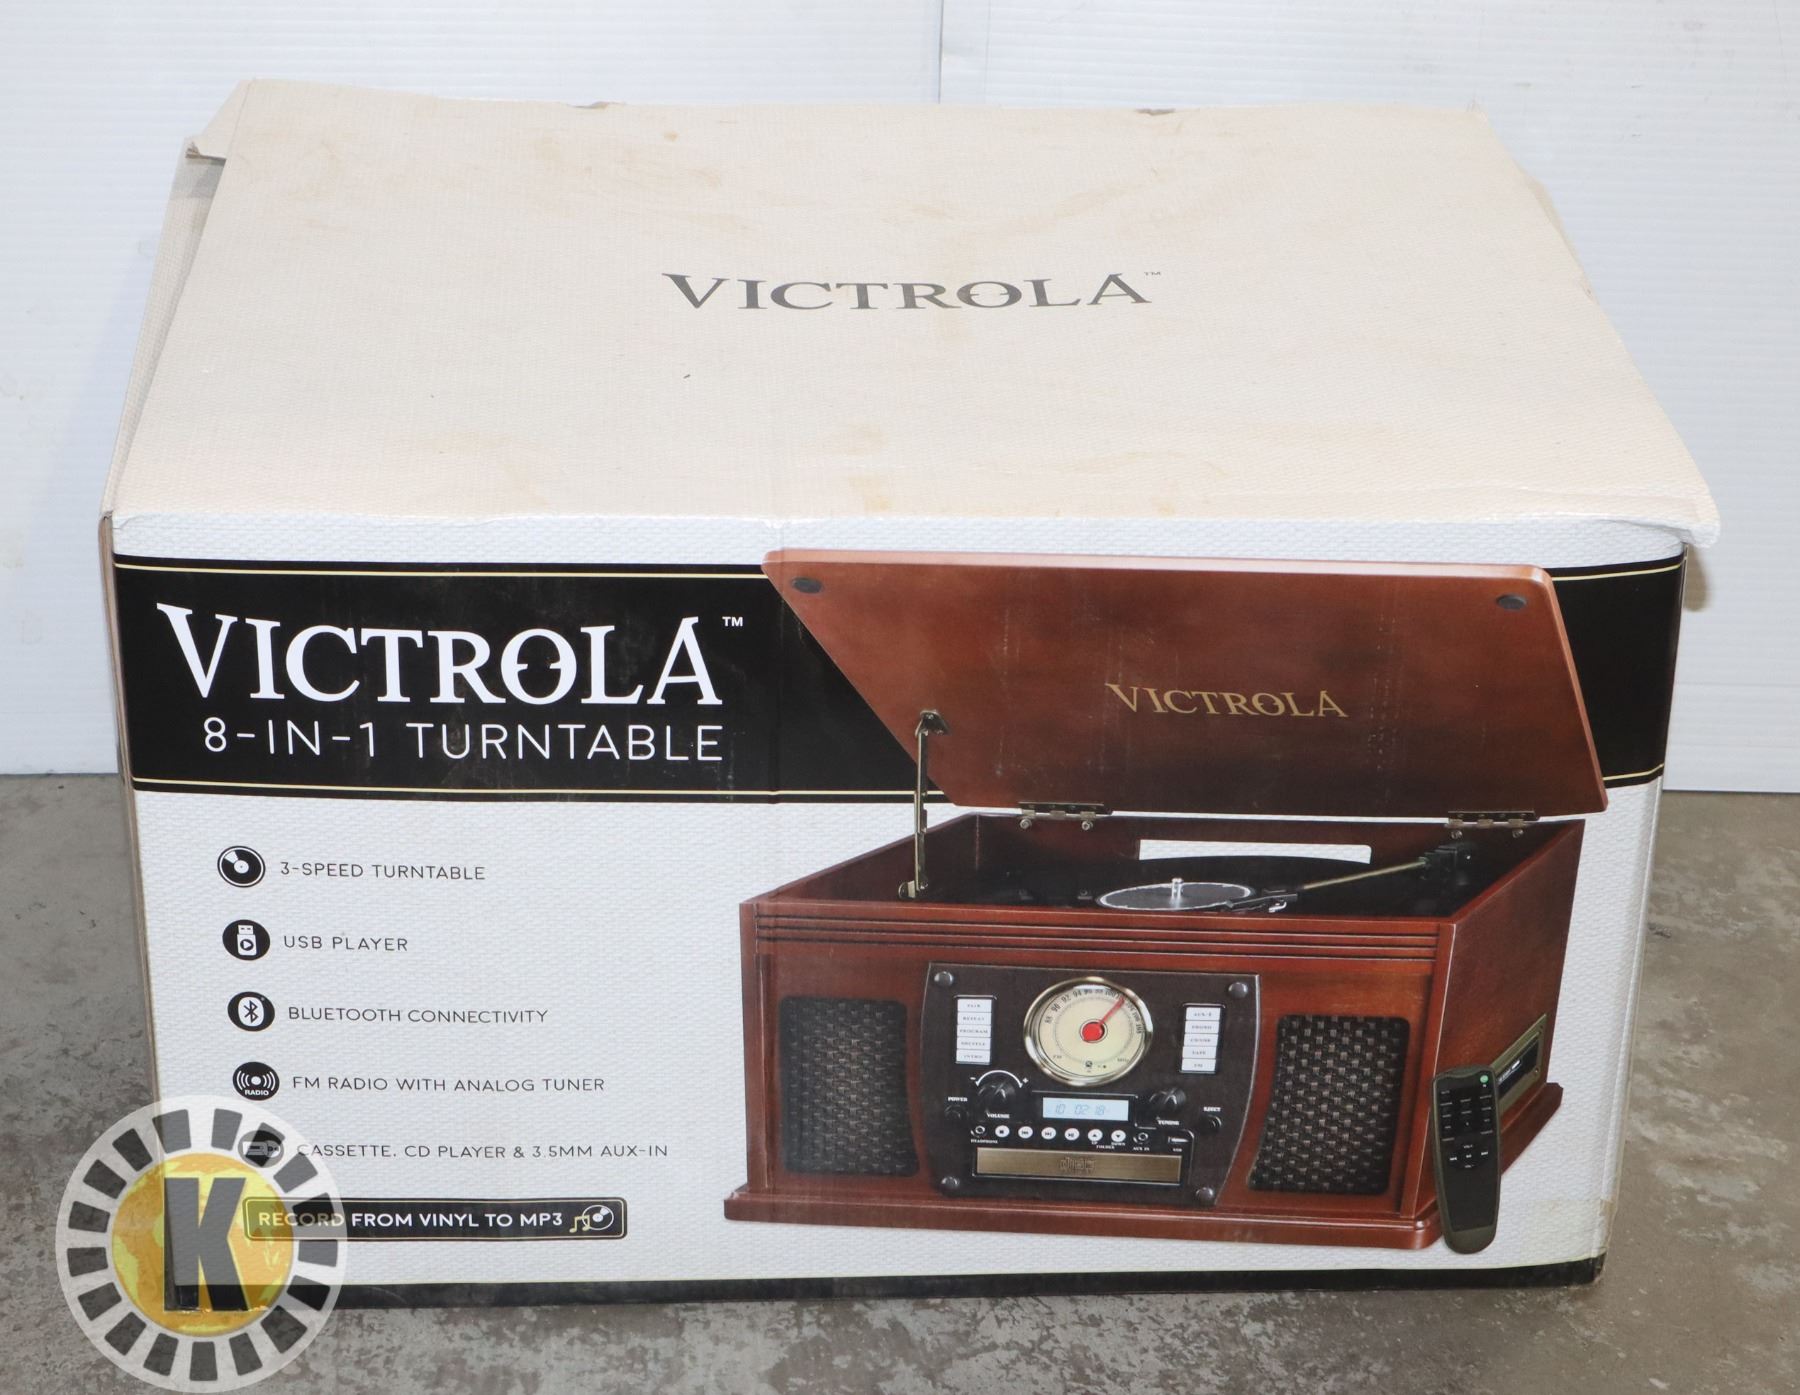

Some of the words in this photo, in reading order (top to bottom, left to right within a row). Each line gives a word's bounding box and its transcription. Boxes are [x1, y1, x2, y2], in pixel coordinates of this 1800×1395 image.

[661, 272, 1153, 310] VICTROLA
[156, 602, 723, 706] VICTROLA
[1105, 683, 1349, 718] VICTROLA
[203, 717, 376, 757] 8-IN-1
[406, 722, 724, 762] TURNTABLE
[280, 861, 364, 879] 3-SPEED
[372, 864, 486, 881] TURNTABLE
[284, 934, 323, 950] USB
[332, 936, 408, 952] PLAYER
[288, 1006, 401, 1022] BLUETOOTH
[407, 1009, 549, 1024] CONNECTIVITY
[244, 1089, 269, 1097] RADIO
[292, 1076, 320, 1089] FM
[328, 1077, 388, 1091] RADIO
[396, 1078, 446, 1092] WITH
[453, 1079, 535, 1093] ANALOG
[542, 1078, 605, 1092] TUNER
[404, 1145, 431, 1158] CD
[438, 1146, 506, 1159] PLAYER
[513, 1146, 526, 1158] &
[532, 1145, 593, 1159] 3.5MM
[600, 1145, 669, 1158] AUX-IN
[258, 1212, 345, 1228] RECORD
[351, 1212, 413, 1228] FROM
[418, 1212, 479, 1228] VINYL
[484, 1213, 514, 1228] TO
[519, 1212, 564, 1228] MP3
